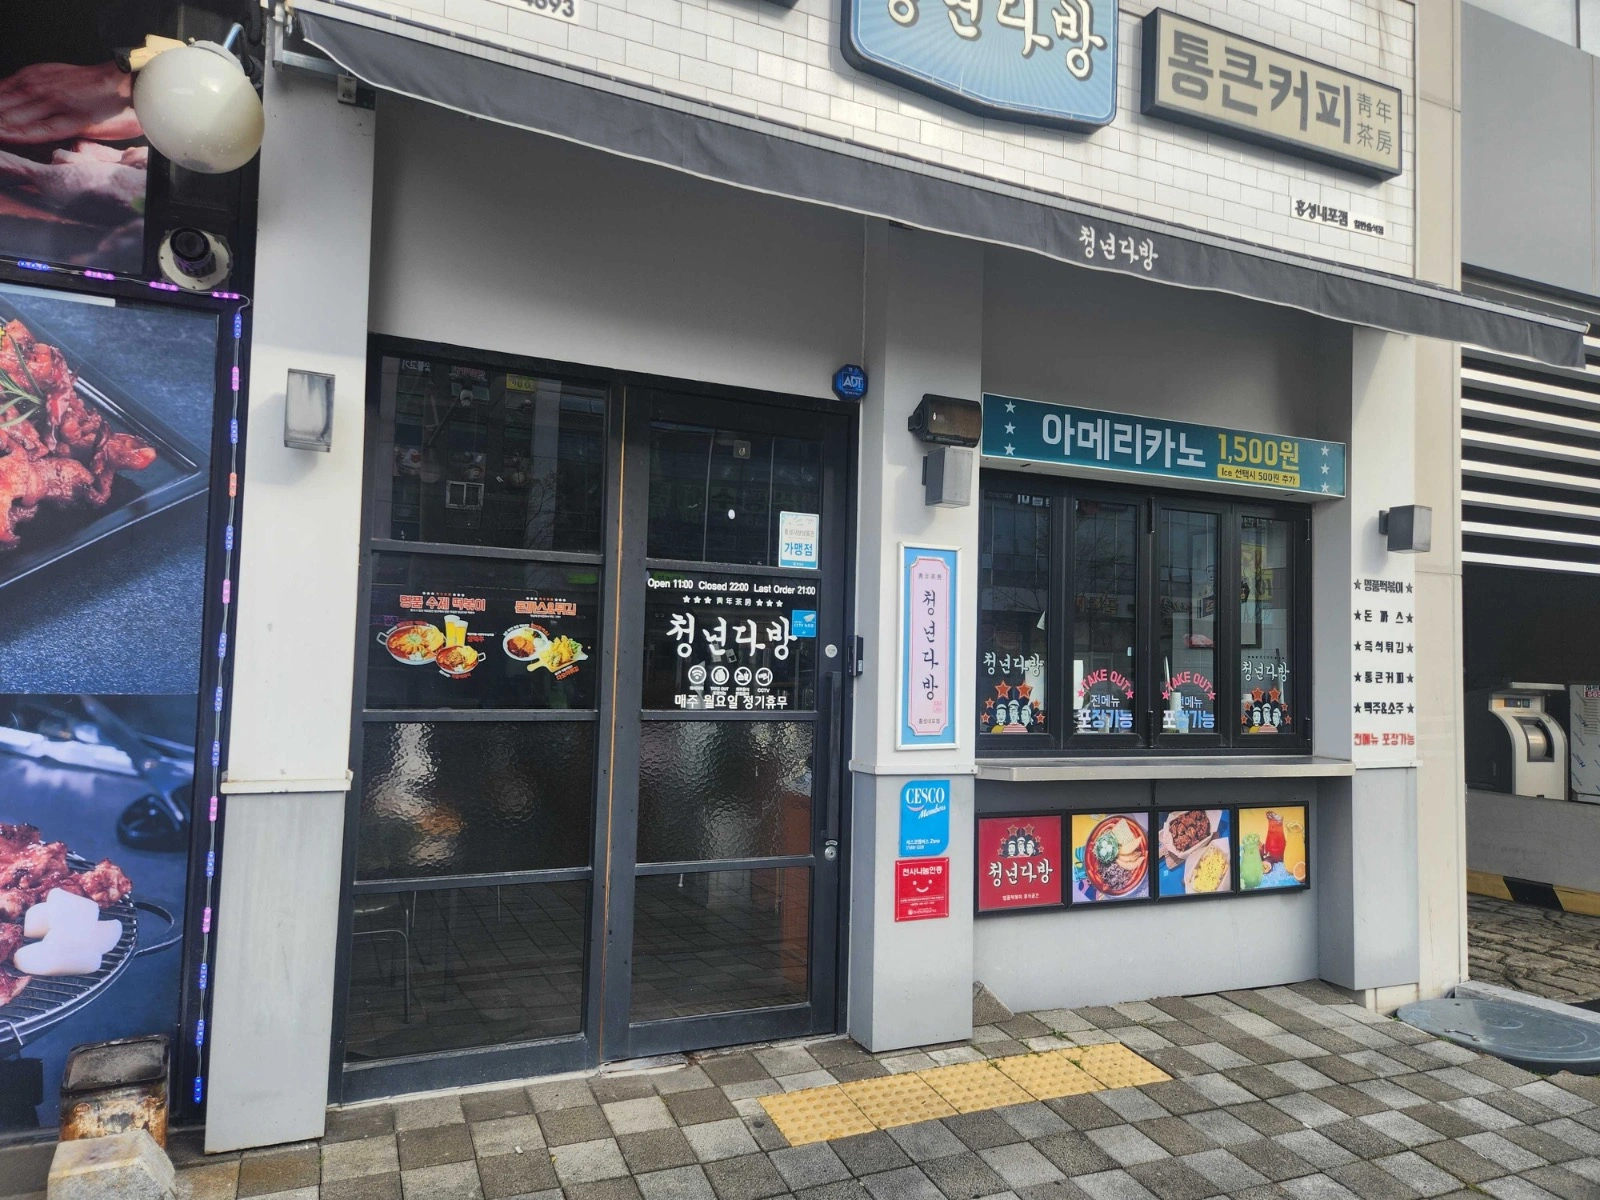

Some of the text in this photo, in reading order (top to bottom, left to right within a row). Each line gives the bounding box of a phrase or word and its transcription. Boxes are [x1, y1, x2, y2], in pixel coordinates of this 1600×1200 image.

[888, 0, 1106, 78] 년다방
[1168, 30, 1351, 144] 통큰커피
[1356, 122, 1392, 155] 茶房
[1295, 199, 1348, 227] 홍성내포점
[1079, 225, 1159, 271] 청년다방
[842, 375, 864, 389] ADT
[1042, 413, 1299, 471] 아메리카노 1,500원
[1221, 467, 1296, 485] Ice 선택시 500원 추가
[784, 542, 813, 557] 가맹점
[647, 578, 816, 595] Open 11:00 Closed 22:00 Last Order 21:00
[1364, 578, 1404, 594] 명품떡볶이
[400, 594, 486, 612] 명품 수제 떡볶이
[666, 612, 798, 660] 청년다방
[922, 589, 940, 701] 청년다방
[1364, 640, 1404, 654] 즉석튀김
[983, 651, 1045, 677] 청년다방
[1241, 660, 1290, 682] 청년다방
[1080, 668, 1132, 691] TAKE OUT
[1165, 671, 1213, 693] TAKE OUT
[1364, 671, 1404, 684] 통큰커피
[674, 694, 788, 710] 매주 월요일 정기휴무
[1091, 694, 1120, 708] 전메뉴
[1364, 702, 1404, 715] 맥주&소주
[1078, 709, 1134, 729] 포장가능
[1163, 710, 1216, 729] 포장가능
[1353, 733, 1415, 746] 전메뉴 포장가능
[905, 787, 945, 804] CESCO
[918, 804, 947, 819] Members
[903, 865, 943, 877] 천사나눔인증
[988, 858, 1053, 887] 청년다방
